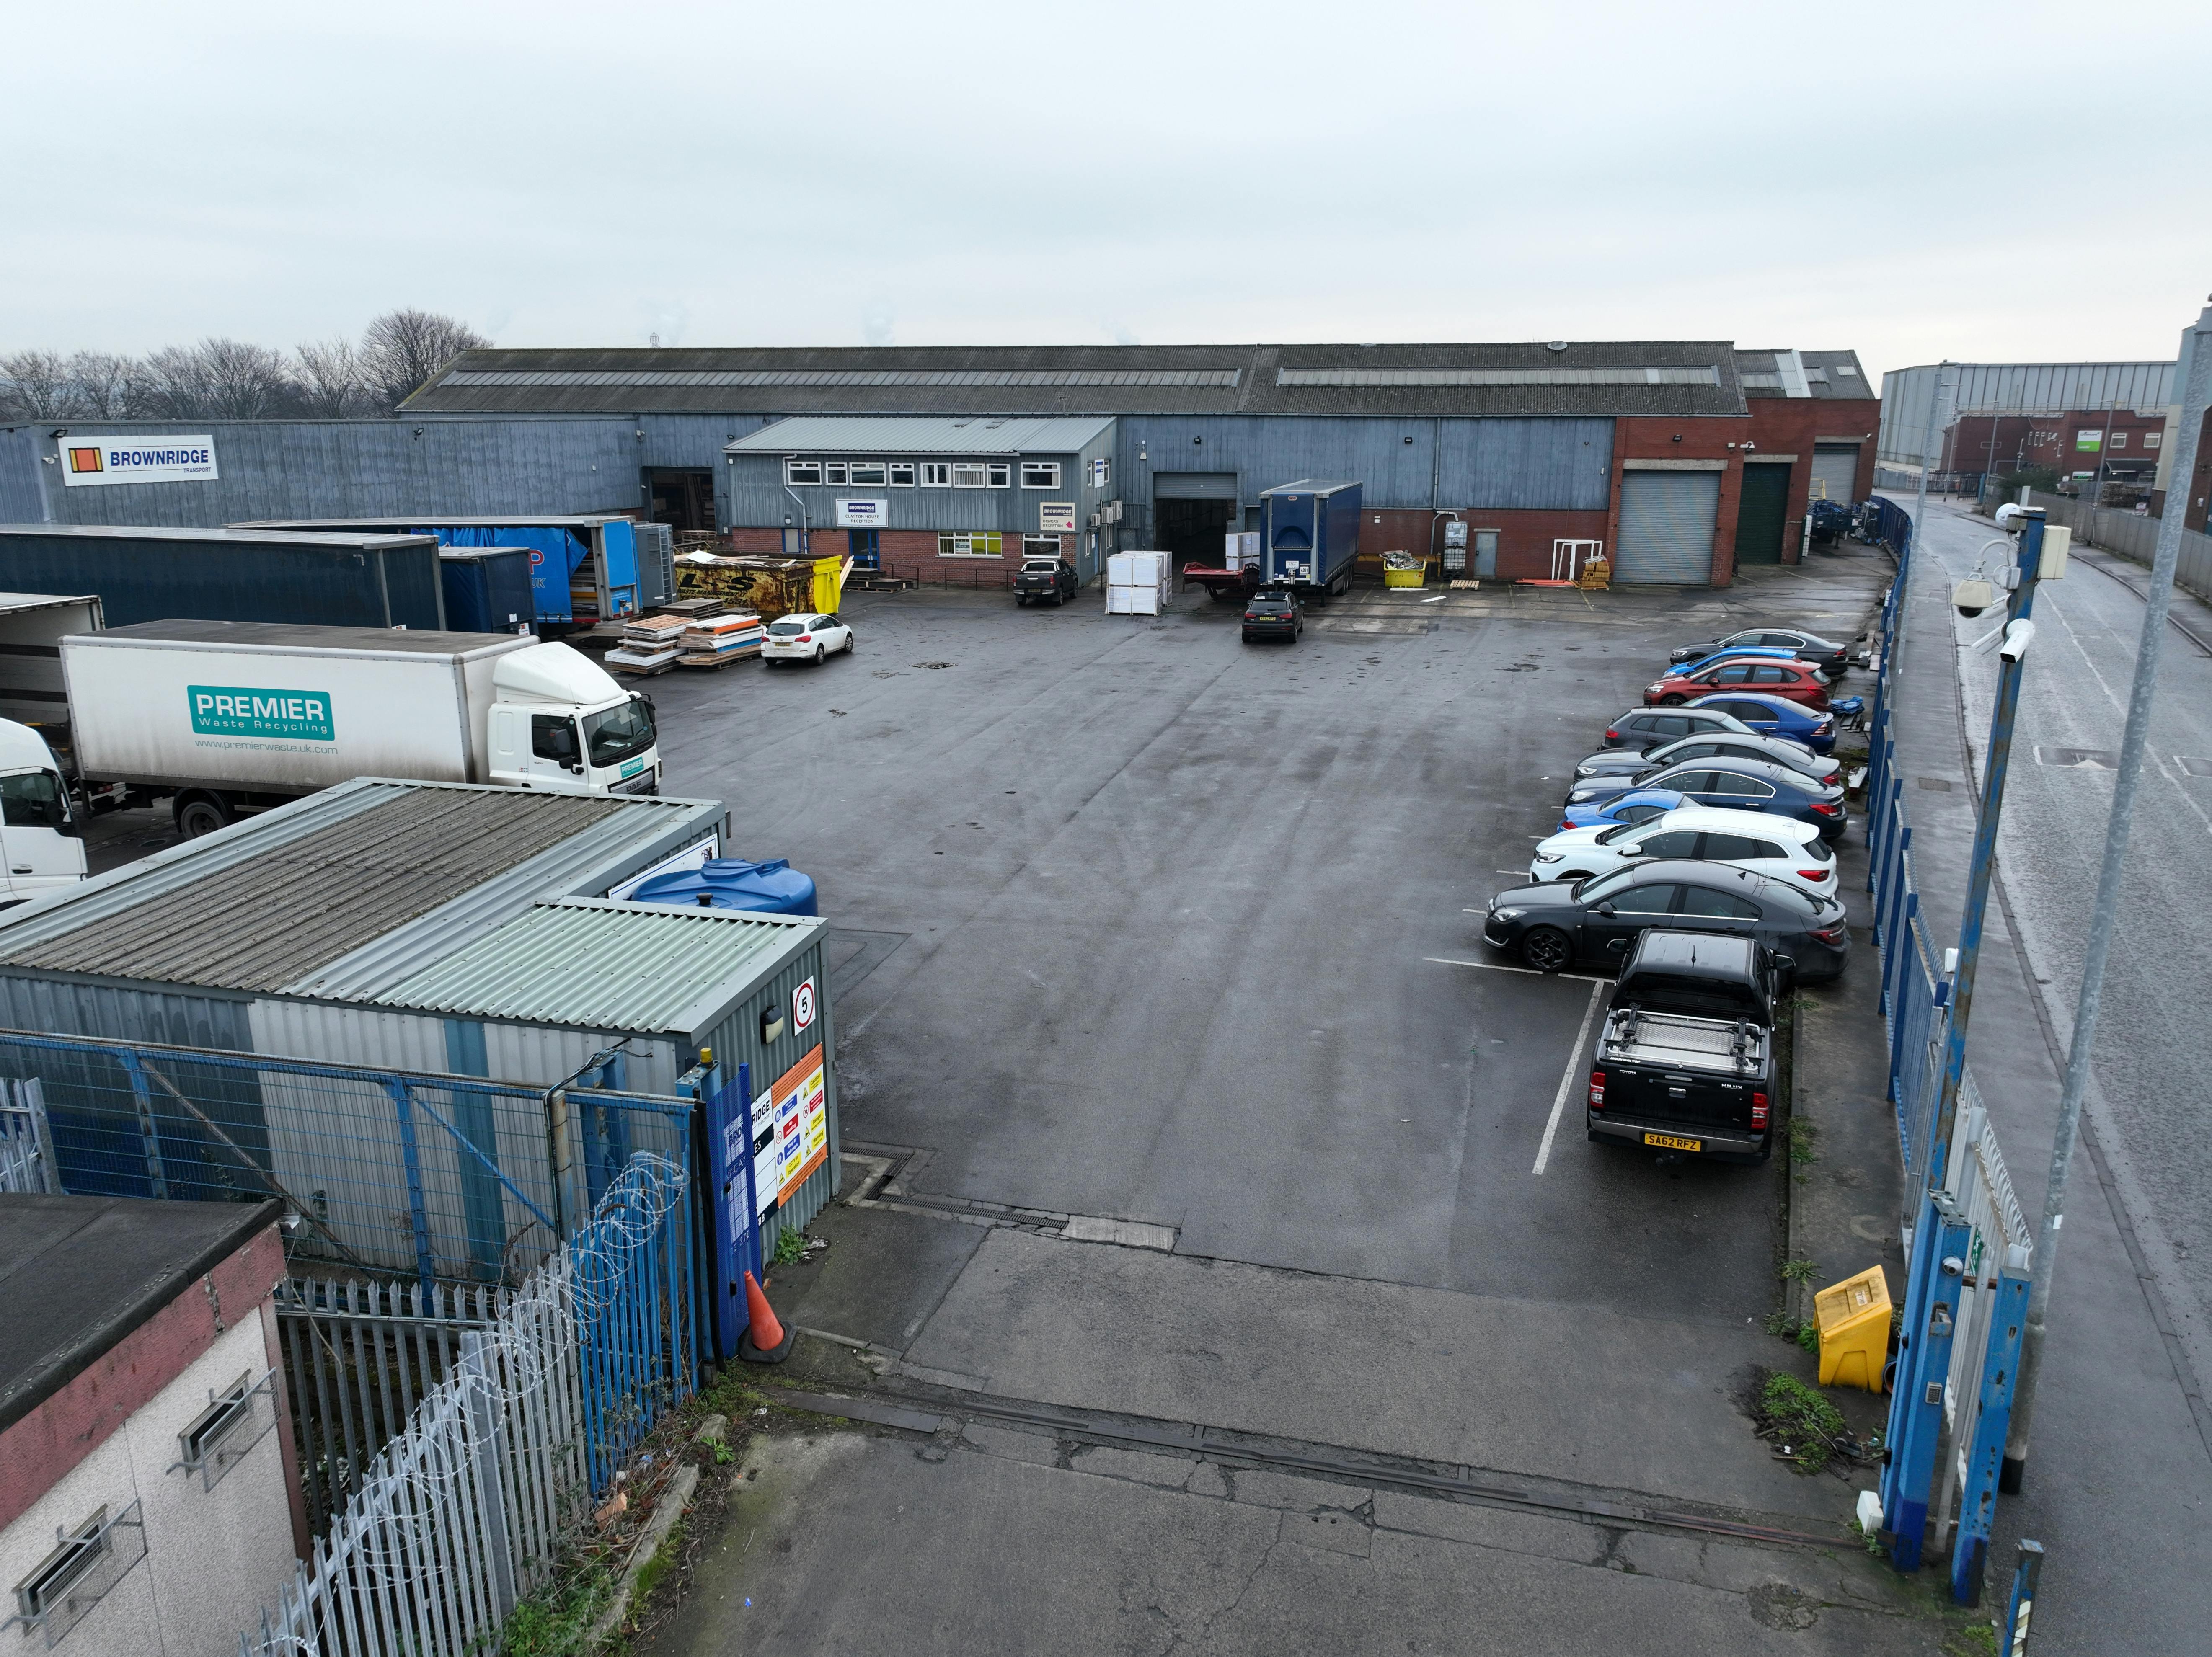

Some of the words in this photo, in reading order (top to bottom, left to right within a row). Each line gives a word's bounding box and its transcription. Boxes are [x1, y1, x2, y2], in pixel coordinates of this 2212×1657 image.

[111, 449, 209, 466] BROWNRIDGE
[196, 694, 325, 721] PREMIER
[199, 718, 245, 728] Waste
[254, 720, 328, 734] Recycling
[194, 740, 338, 754] www.premierwaste.uk.com
[622, 759, 643, 773] PREMIER
[626, 781, 641, 792] DAF
[802, 996, 807, 1014] 5
[1649, 1135, 1674, 1146] SA62
[1677, 1139, 1697, 1149] RFZ
